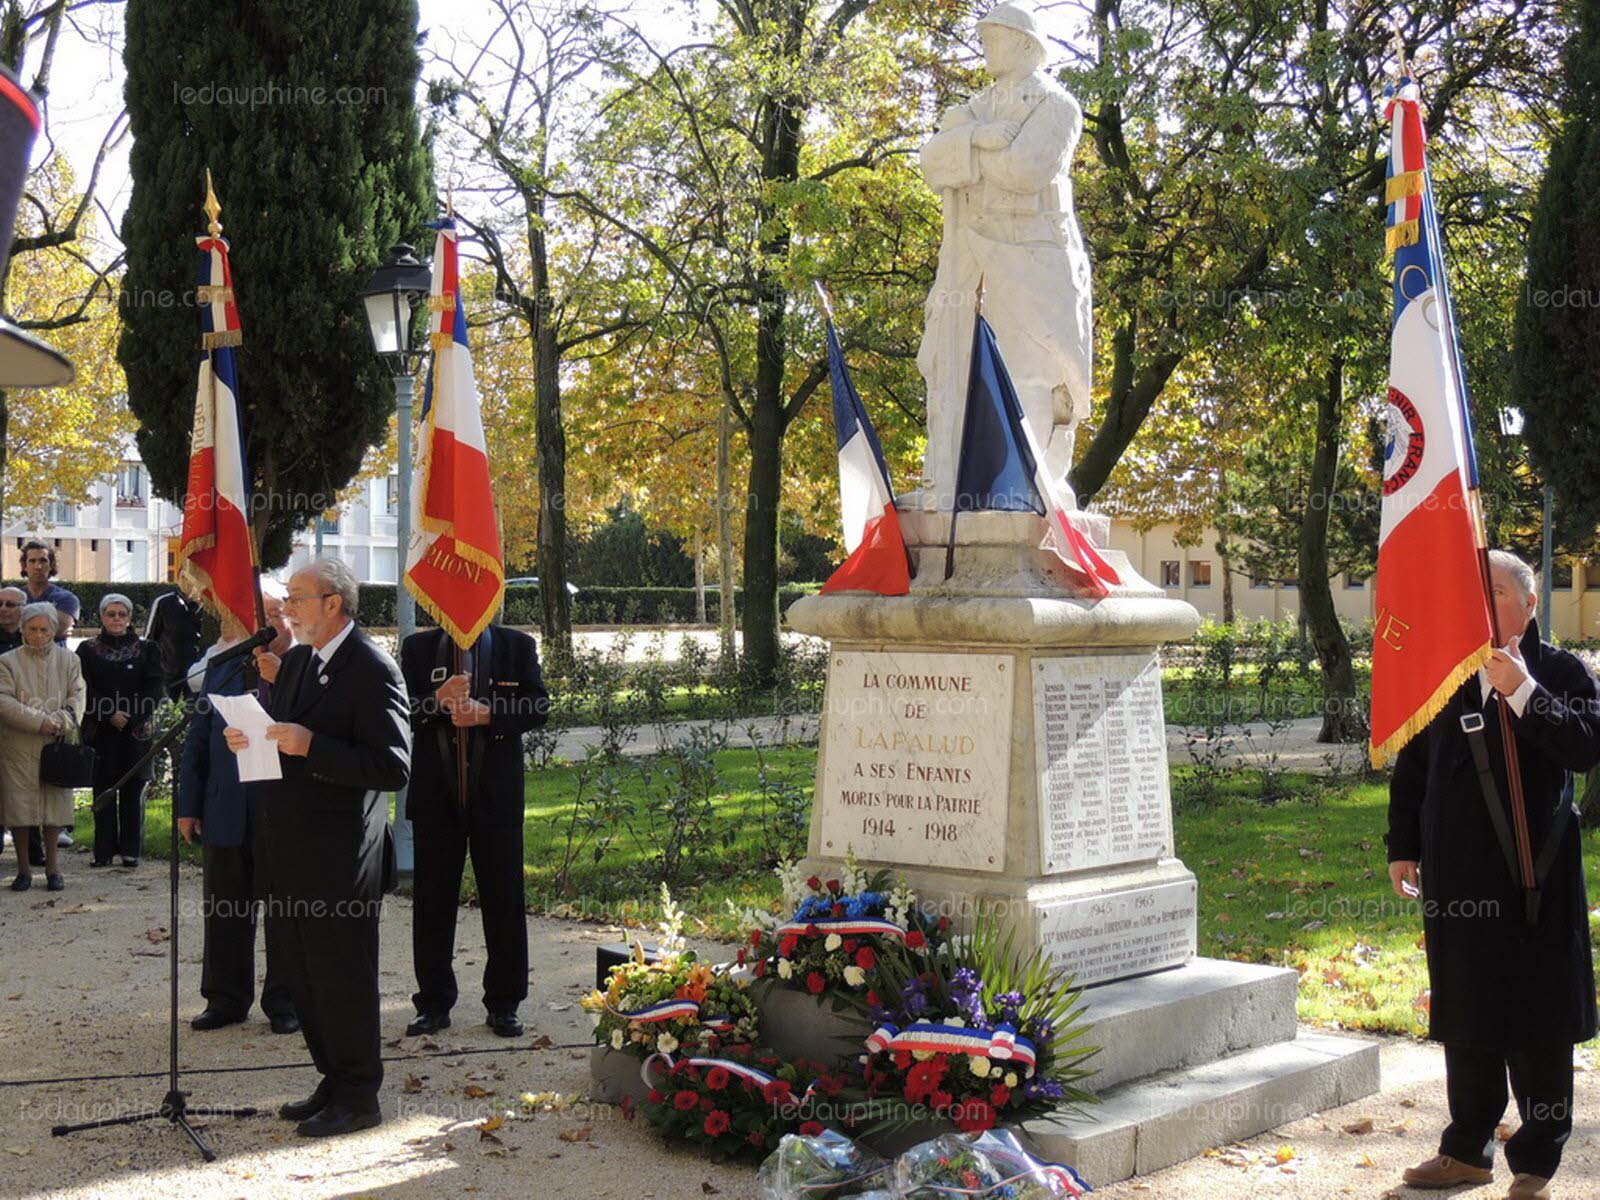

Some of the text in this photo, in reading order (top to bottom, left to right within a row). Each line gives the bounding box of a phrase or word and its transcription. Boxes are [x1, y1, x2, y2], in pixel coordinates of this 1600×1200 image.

[863, 673, 972, 692] LA COMMUNE
[904, 704, 926, 719] DE
[855, 727, 975, 755] LAPALUD
[853, 762, 972, 784] A SES ENFANTS
[840, 790, 983, 815] MORTS POUR LA PATRIE
[862, 817, 896, 837] 1914
[925, 823, 958, 842] 1918
